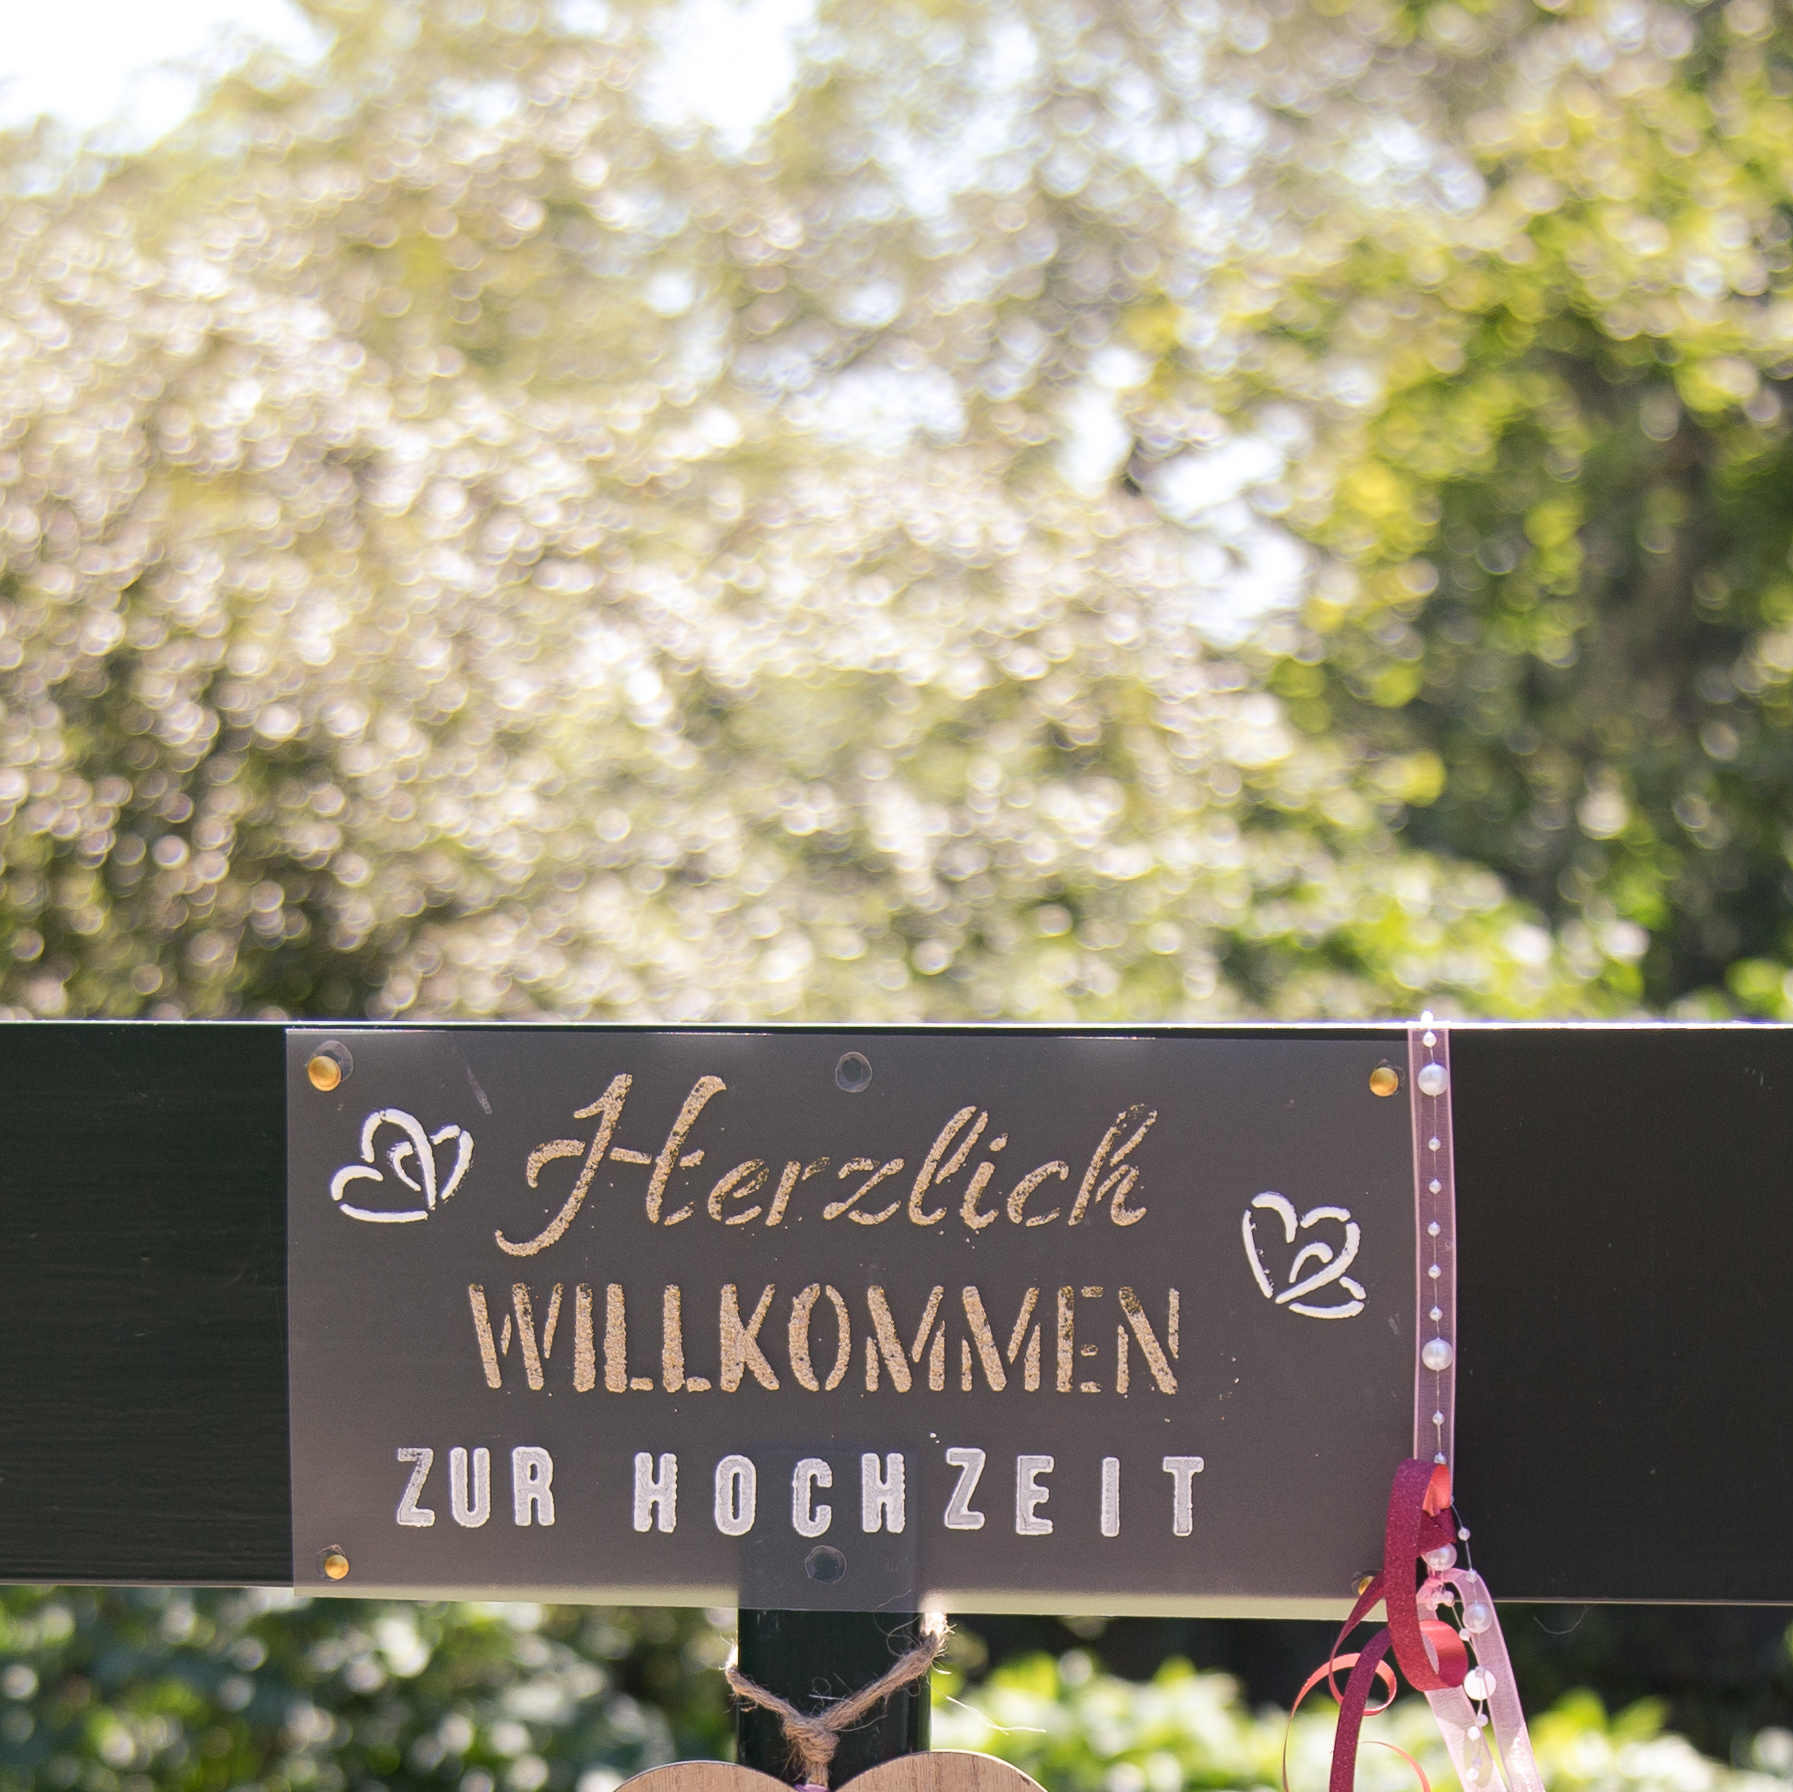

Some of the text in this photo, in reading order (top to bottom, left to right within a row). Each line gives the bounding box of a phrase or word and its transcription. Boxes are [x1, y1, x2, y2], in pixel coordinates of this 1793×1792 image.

[494, 1073, 1159, 1257] Herzlich
[468, 1282, 1181, 1395] WILLKOMMEN
[395, 1446, 1206, 1538] ZUR HOCHZEIT
